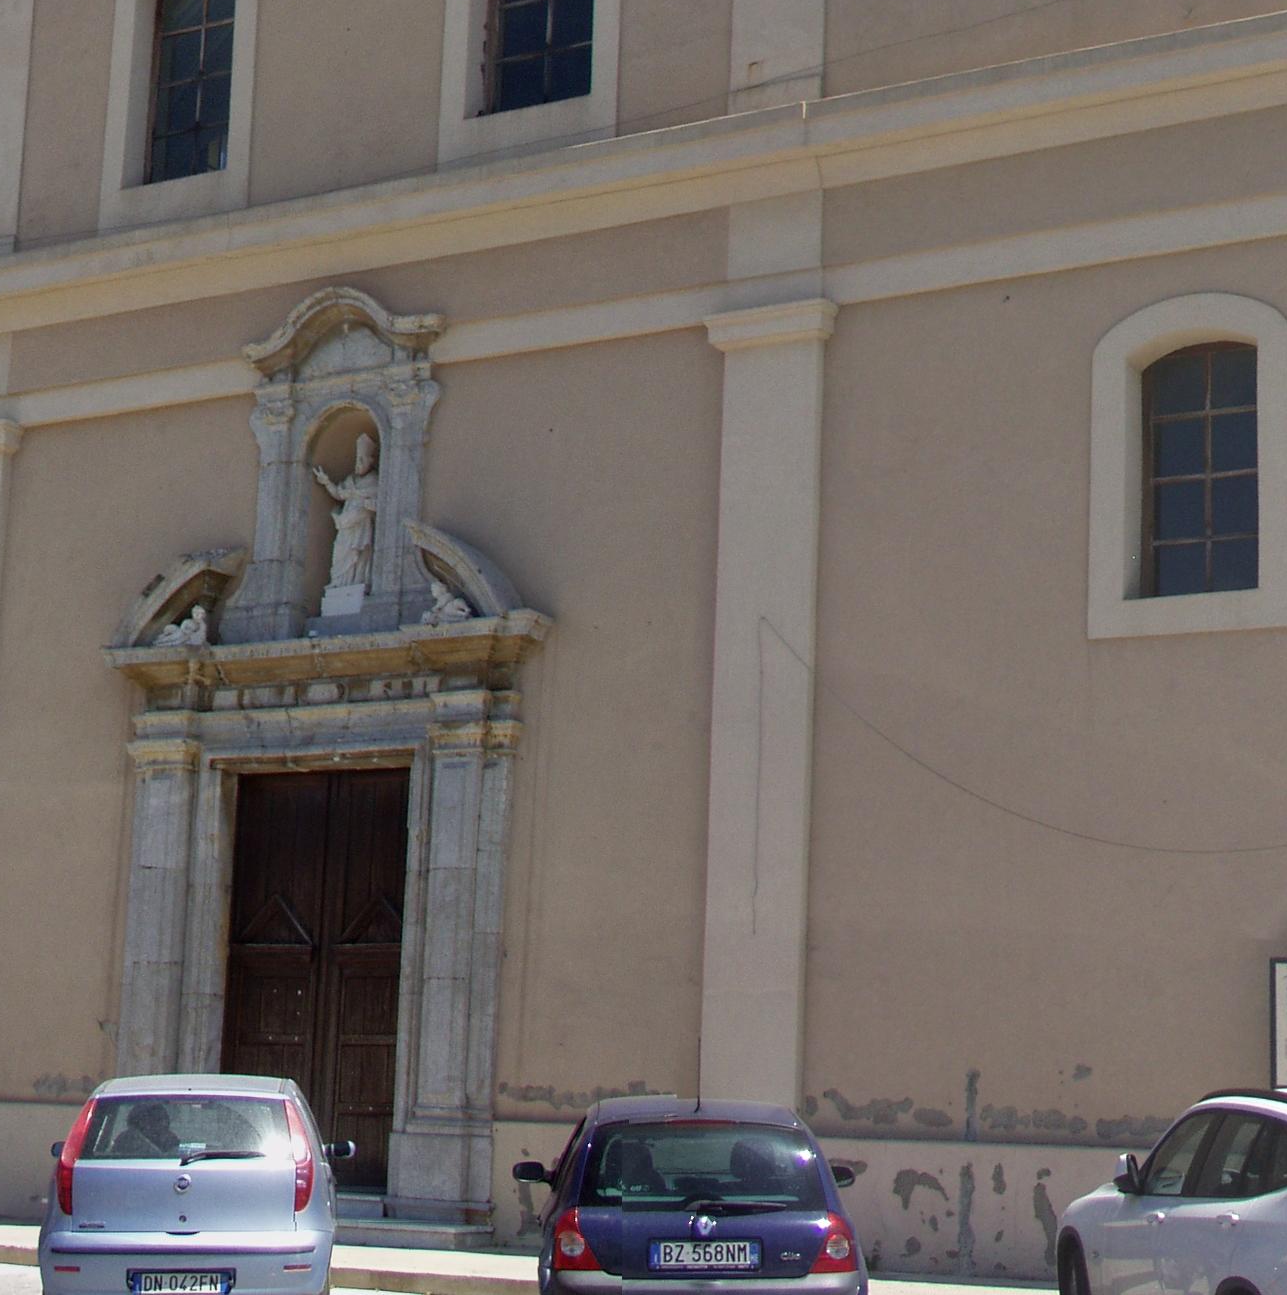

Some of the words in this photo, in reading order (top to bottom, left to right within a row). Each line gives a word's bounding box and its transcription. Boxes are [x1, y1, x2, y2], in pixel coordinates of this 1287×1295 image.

[663, 1244, 685, 1263] BZ
[692, 1244, 748, 1263] 568NM
[143, 1275, 163, 1292] DN
[169, 1275, 219, 1292] 042FN
